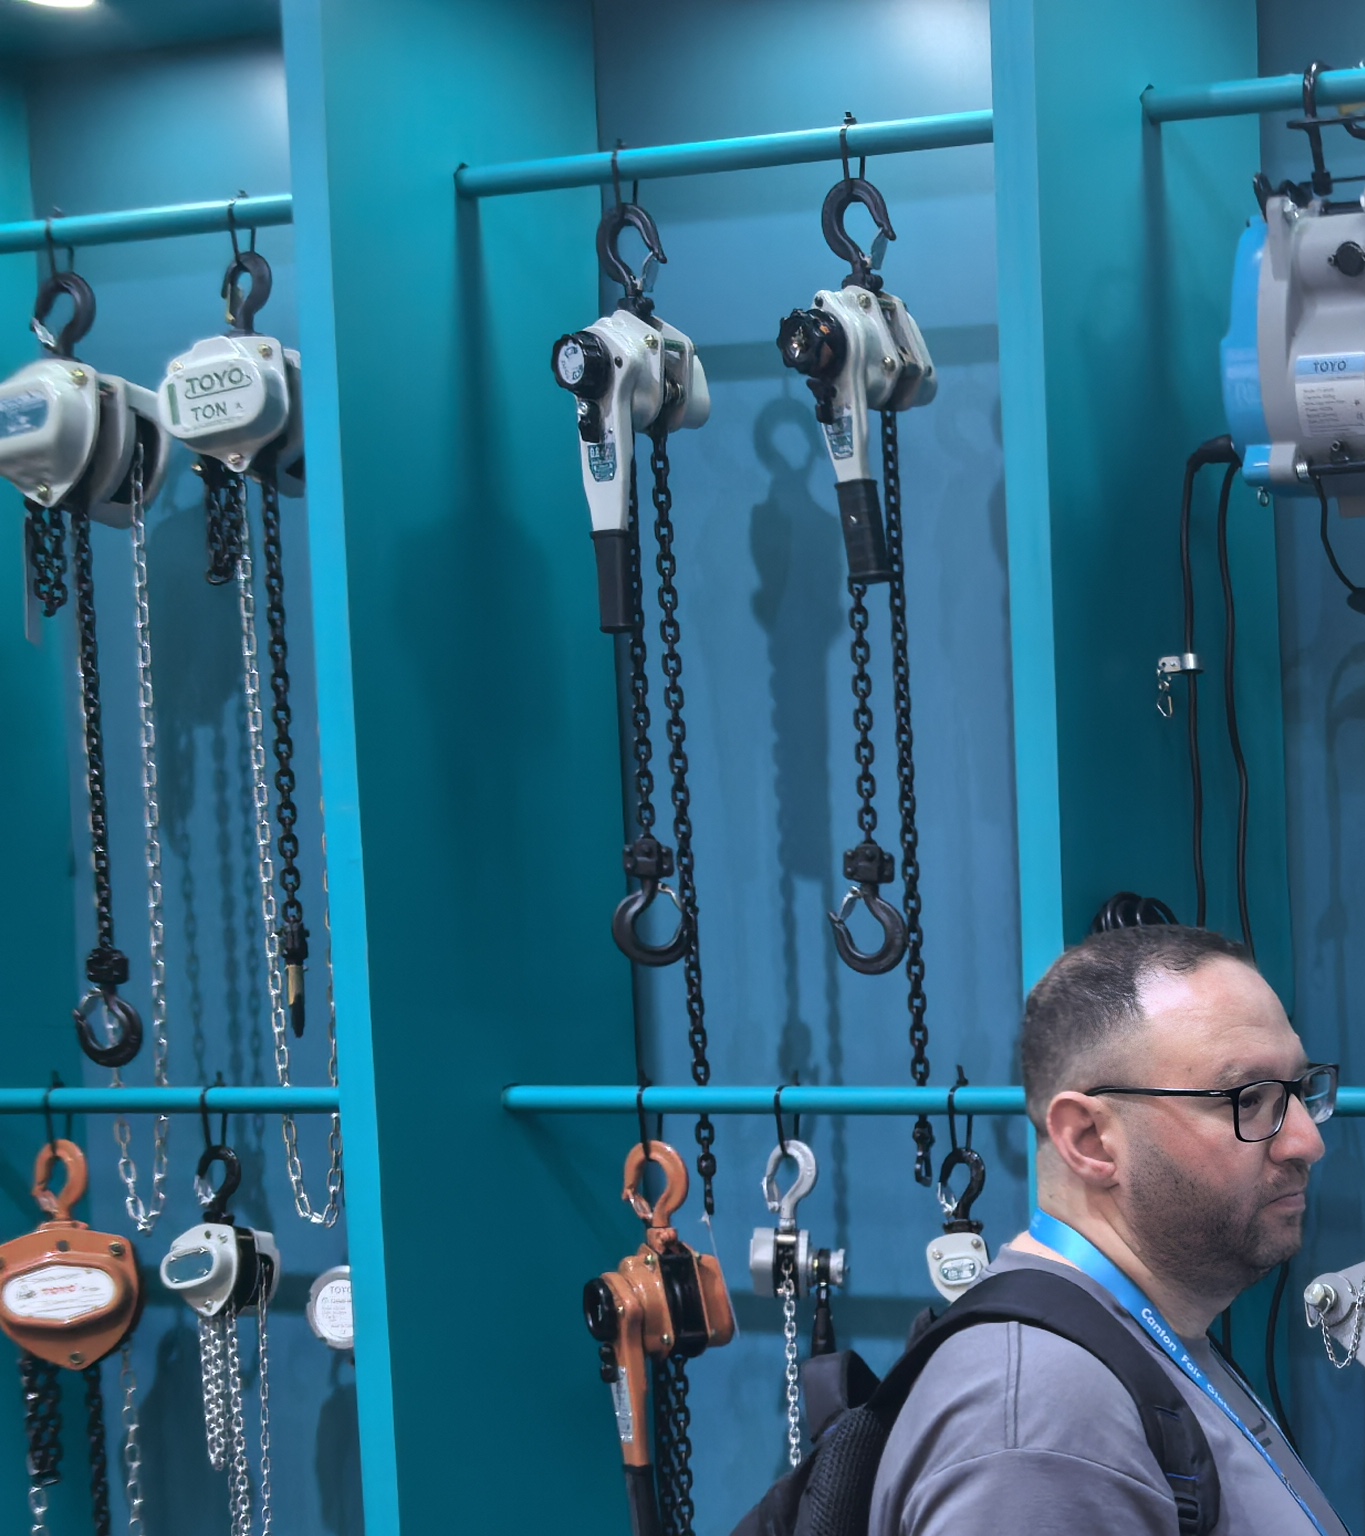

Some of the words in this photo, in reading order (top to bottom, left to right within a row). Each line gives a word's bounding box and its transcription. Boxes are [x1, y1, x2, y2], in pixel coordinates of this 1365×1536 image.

[1313, 360, 1347, 373] TOYO
[186, 367, 244, 396] TOYO
[191, 401, 228, 420] TON
[1141, 1308, 1177, 1352] Canton
[1181, 1354, 1202, 1379] Fair
